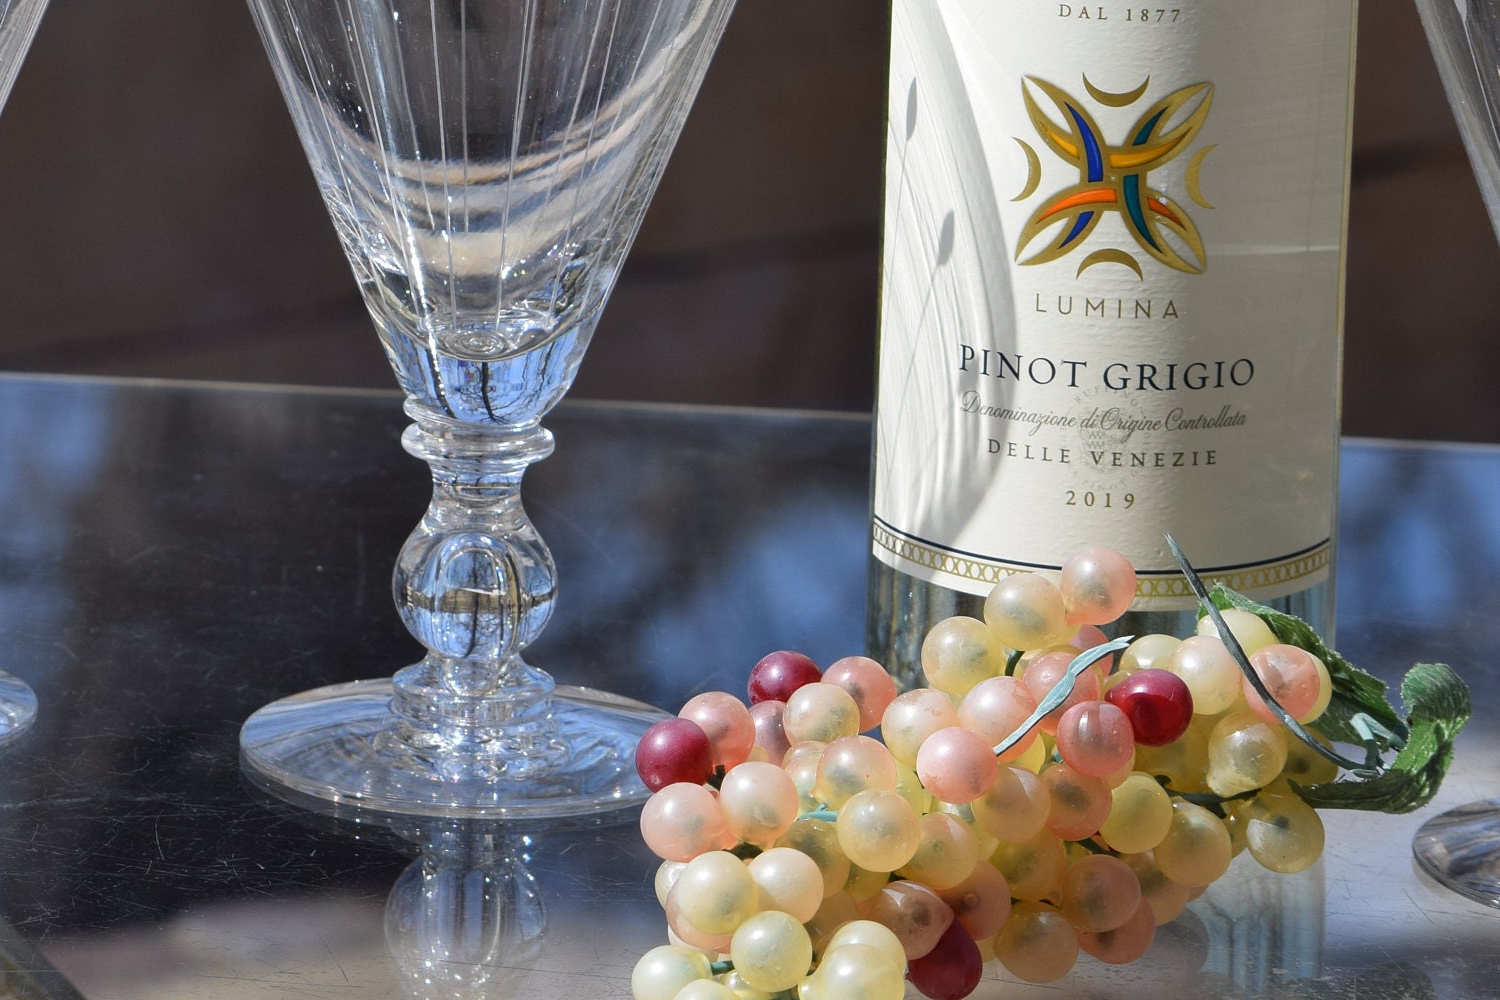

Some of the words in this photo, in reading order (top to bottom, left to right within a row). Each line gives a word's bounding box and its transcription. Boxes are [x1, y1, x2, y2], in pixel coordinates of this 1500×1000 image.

[1058, 3, 1108, 21] DAL
[1125, 8, 1183, 23] 1877
[1035, 293, 1180, 320] LUMINA
[958, 343, 1088, 388] PINOT
[1102, 358, 1255, 391] GRIGIO
[960, 390, 1077, 436] Denominazione
[1080, 406, 1099, 427] di
[1100, 407, 1162, 443] Origine
[1165, 404, 1247, 432] Controllata
[987, 438, 1071, 464] DELLE
[1090, 450, 1218, 468] VENEZIE
[1065, 490, 1136, 510] 2019
